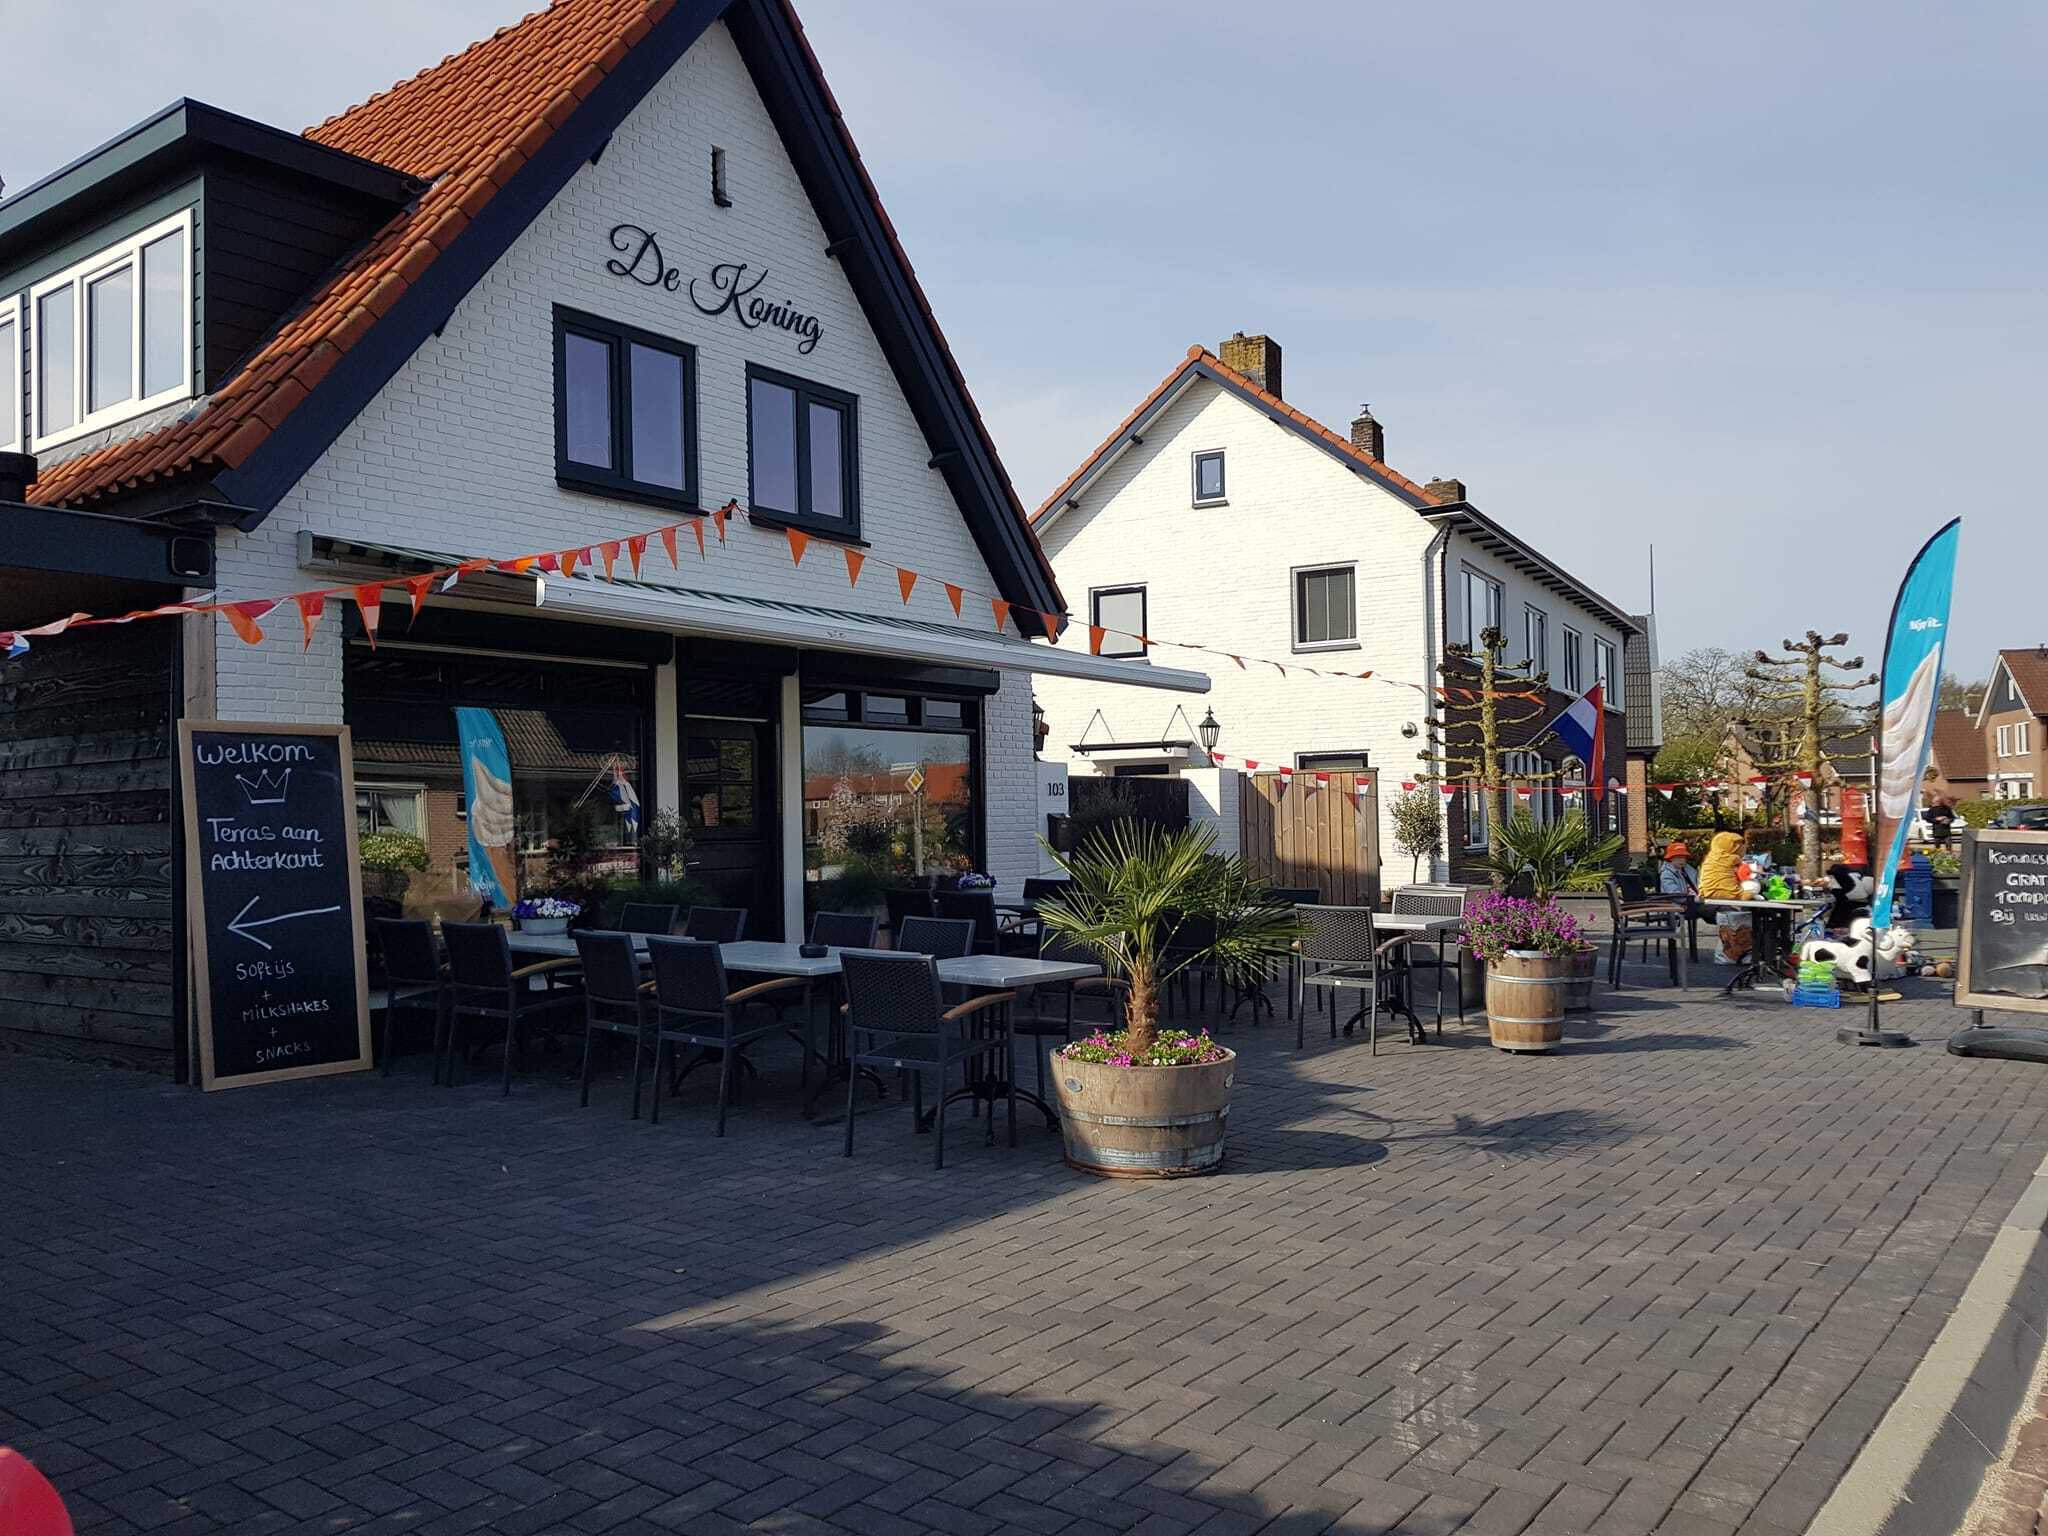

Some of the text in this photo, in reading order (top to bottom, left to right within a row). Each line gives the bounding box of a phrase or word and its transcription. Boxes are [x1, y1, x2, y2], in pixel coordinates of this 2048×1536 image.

[607, 224, 824, 355] De Koning
[197, 743, 315, 764] Welkom
[1048, 782, 1065, 796] 103
[206, 818, 324, 842] Terras aan
[211, 848, 324, 871] Achterkant
